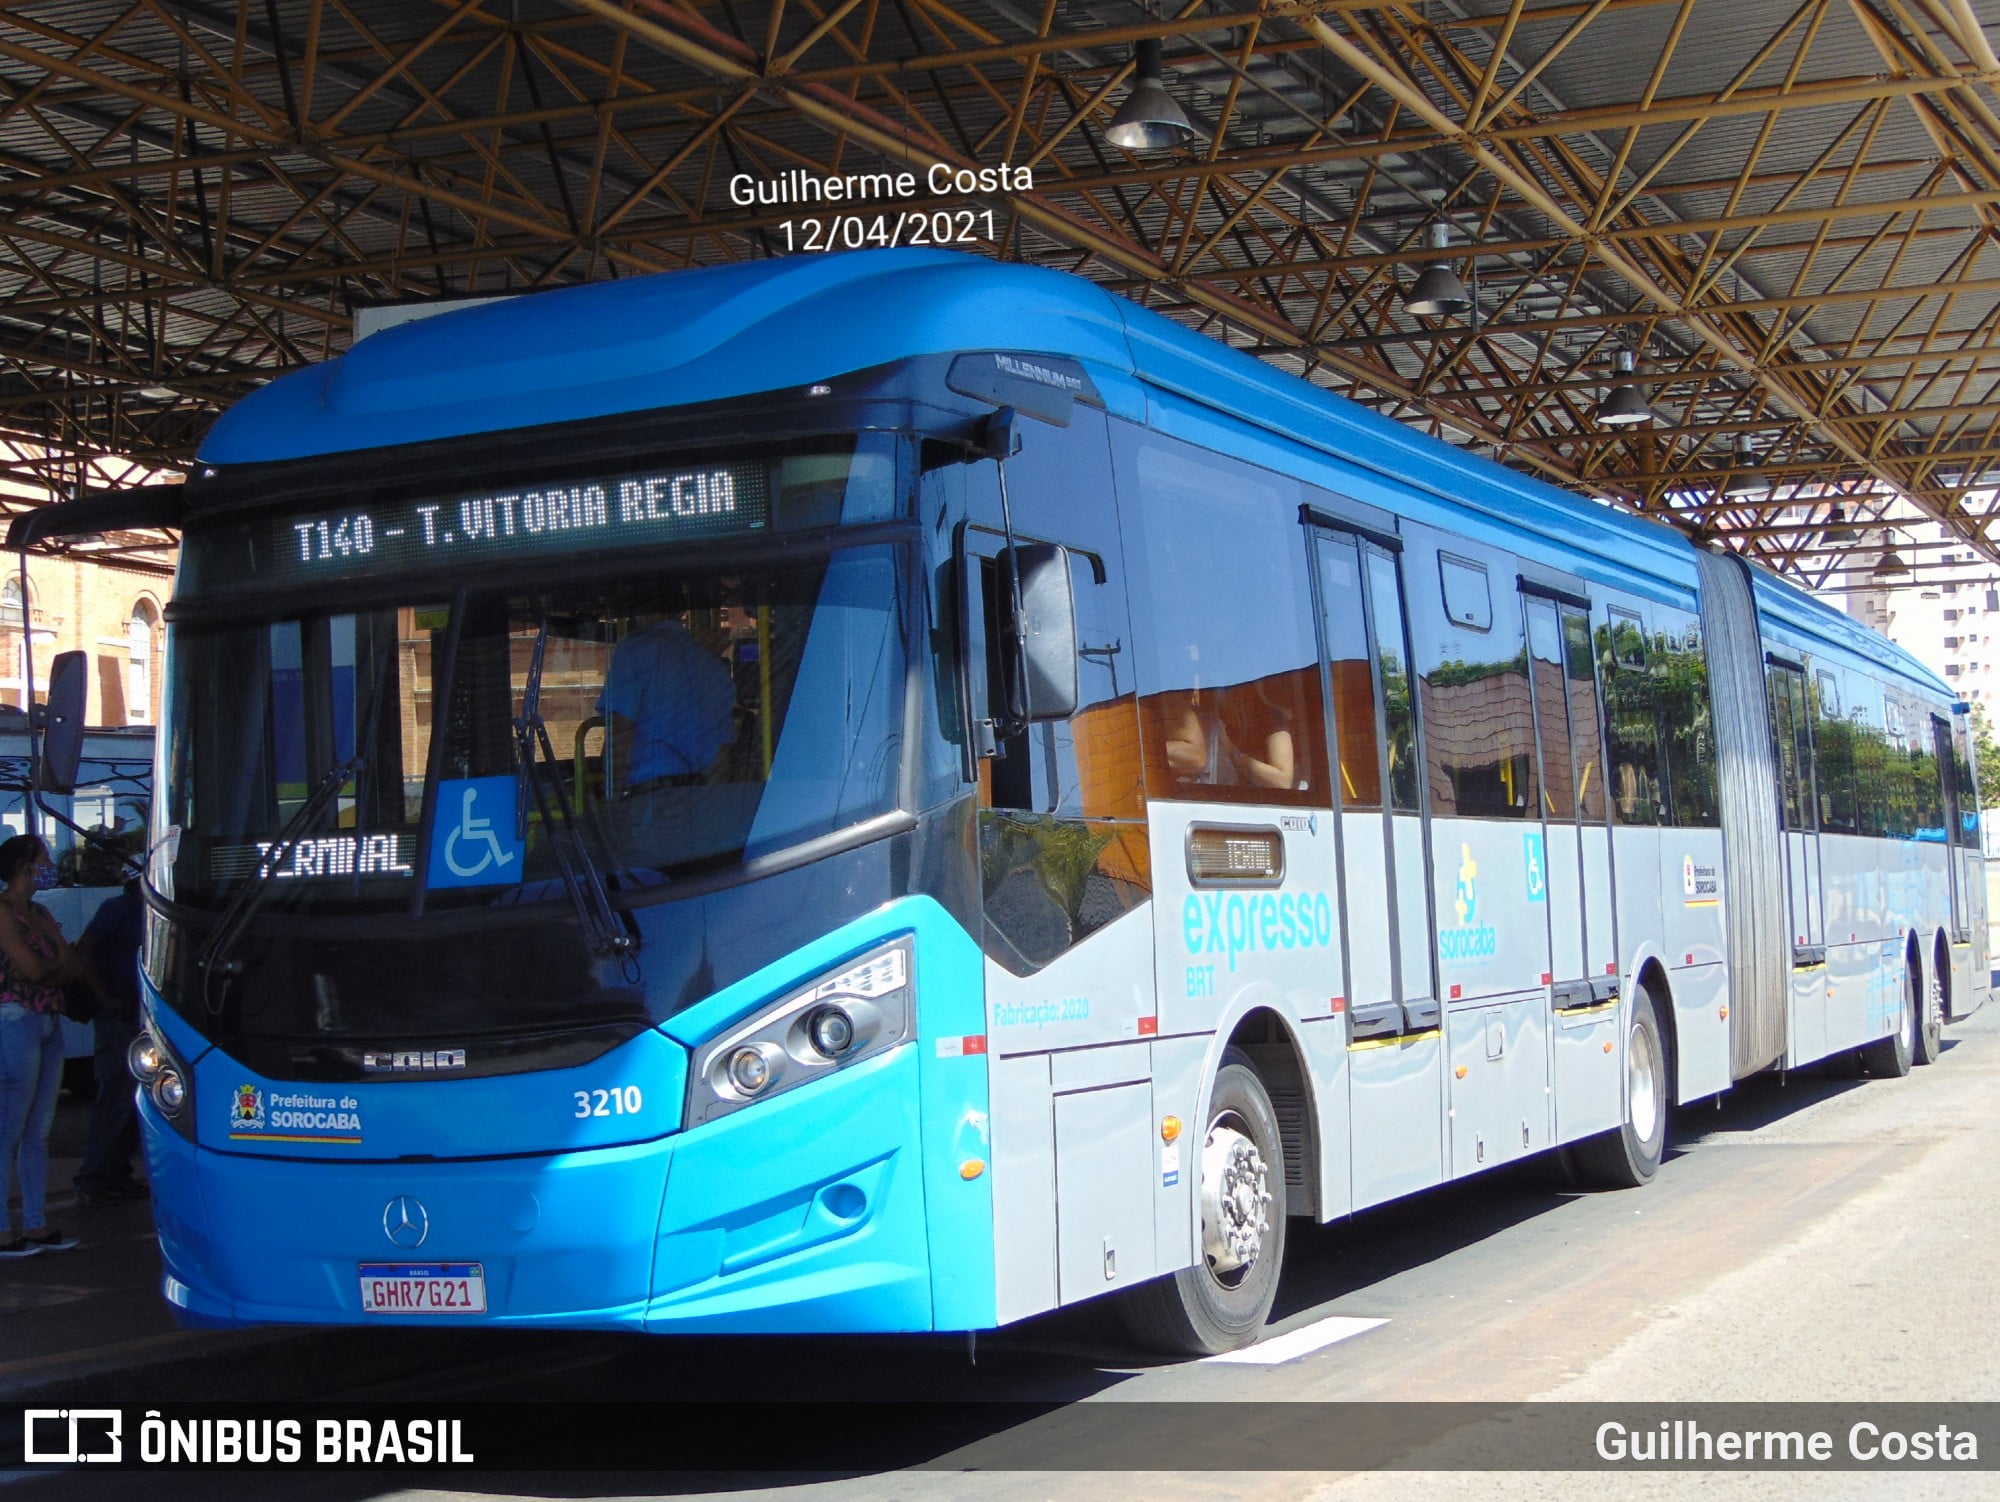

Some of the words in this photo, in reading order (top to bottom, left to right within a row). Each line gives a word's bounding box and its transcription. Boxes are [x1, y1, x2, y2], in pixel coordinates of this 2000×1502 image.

[994, 353, 1066, 390] MILLENNIUM
[294, 514, 374, 562] T140
[416, 484, 606, 546] T.VITORIA
[619, 471, 735, 523] REGIA
[1439, 920, 1496, 960] sorocaba
[1186, 965, 1215, 998] BRT
[993, 1001, 1060, 1031] Fabricação:
[1062, 997, 1089, 1020] 2020
[363, 1049, 466, 1072] CAIO
[270, 1093, 336, 1108] Prefeitura
[340, 1096, 358, 1109] de
[574, 1086, 642, 1118] 3210
[271, 1111, 361, 1130] SOROCABA
[372, 1280, 472, 1307] GHR7G21
